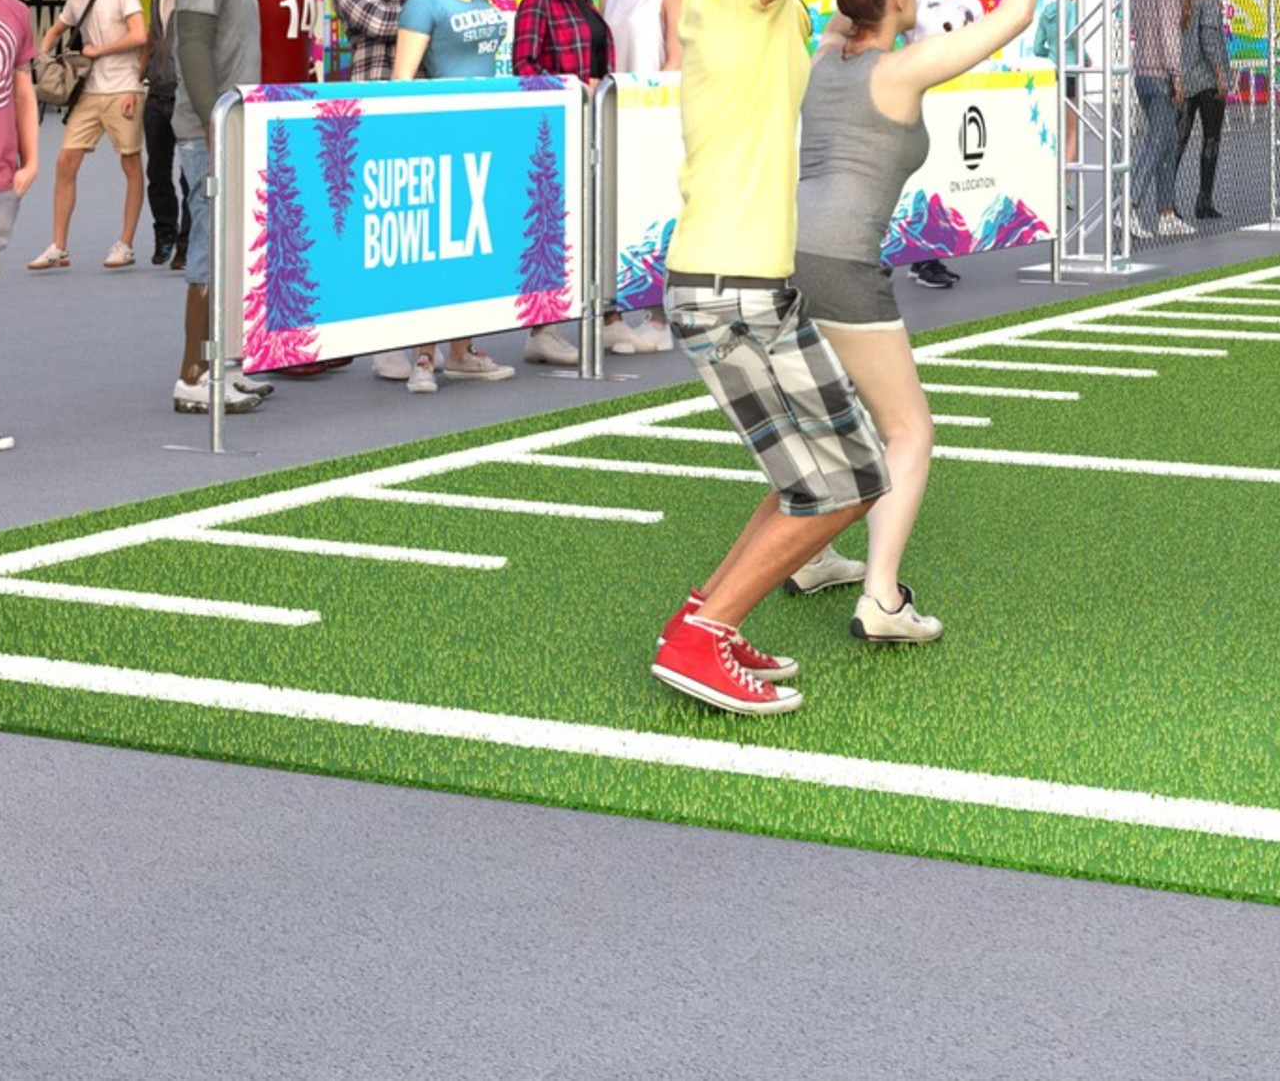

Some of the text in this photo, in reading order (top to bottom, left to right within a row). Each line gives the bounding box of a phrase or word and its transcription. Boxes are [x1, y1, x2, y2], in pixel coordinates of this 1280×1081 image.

[363, 155, 436, 211] SUPER
[438, 150, 494, 260] LX
[363, 207, 437, 270] BOWL
